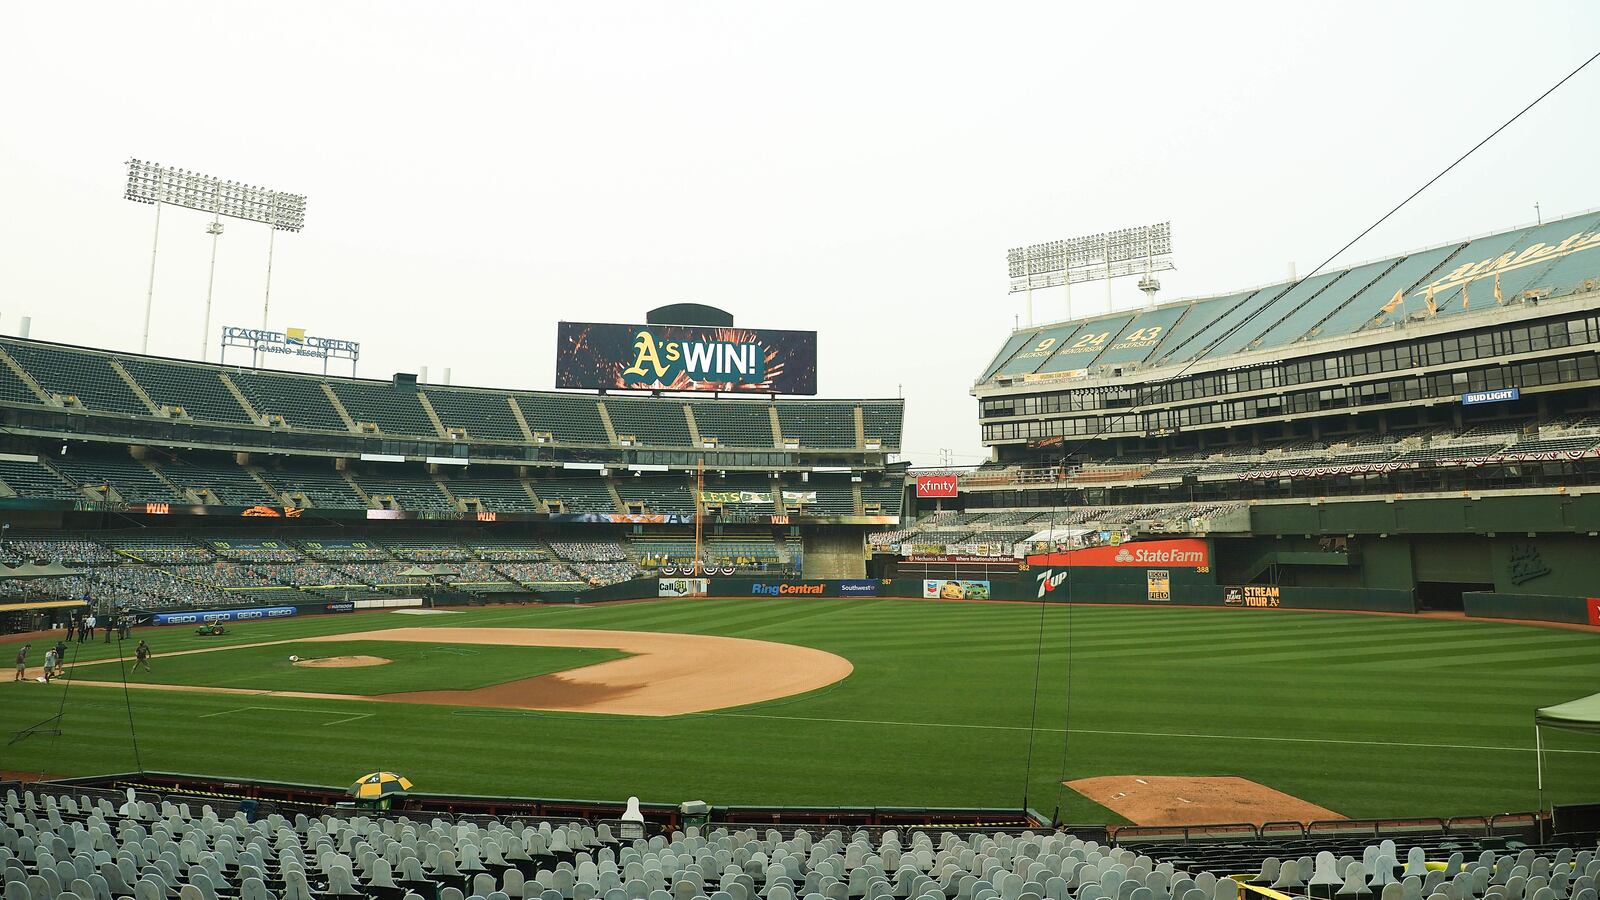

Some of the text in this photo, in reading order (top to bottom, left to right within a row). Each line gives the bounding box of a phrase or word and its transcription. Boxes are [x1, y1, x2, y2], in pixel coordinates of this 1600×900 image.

[1125, 326, 1163, 341] 43
[229, 327, 356, 351] CACHE CREEK
[1073, 332, 1110, 347] 24
[1034, 338, 1056, 351] 9
[1111, 339, 1157, 350] ECKERSLEY
[259, 345, 326, 359] CASINO RESORT
[623, 331, 756, 377] A's WIN!
[1016, 351, 1053, 359] JACKSON
[1060, 345, 1104, 355] HENDERSON
[1467, 391, 1512, 402] BUD LIGHT
[920, 480, 955, 493] xfinity
[146, 503, 169, 514] WIN
[477, 512, 496, 521] WIN
[771, 515, 789, 524] WIN
[659, 582, 674, 591] Call
[752, 584, 824, 595] RingCentral
[1244, 587, 1279, 597] STREAM
[1245, 597, 1267, 606] YOUR
[203, 613, 231, 622] GEICO
[237, 611, 263, 619] GEICO
[268, 609, 292, 617] GEICO
[168, 615, 197, 624] GEICO
